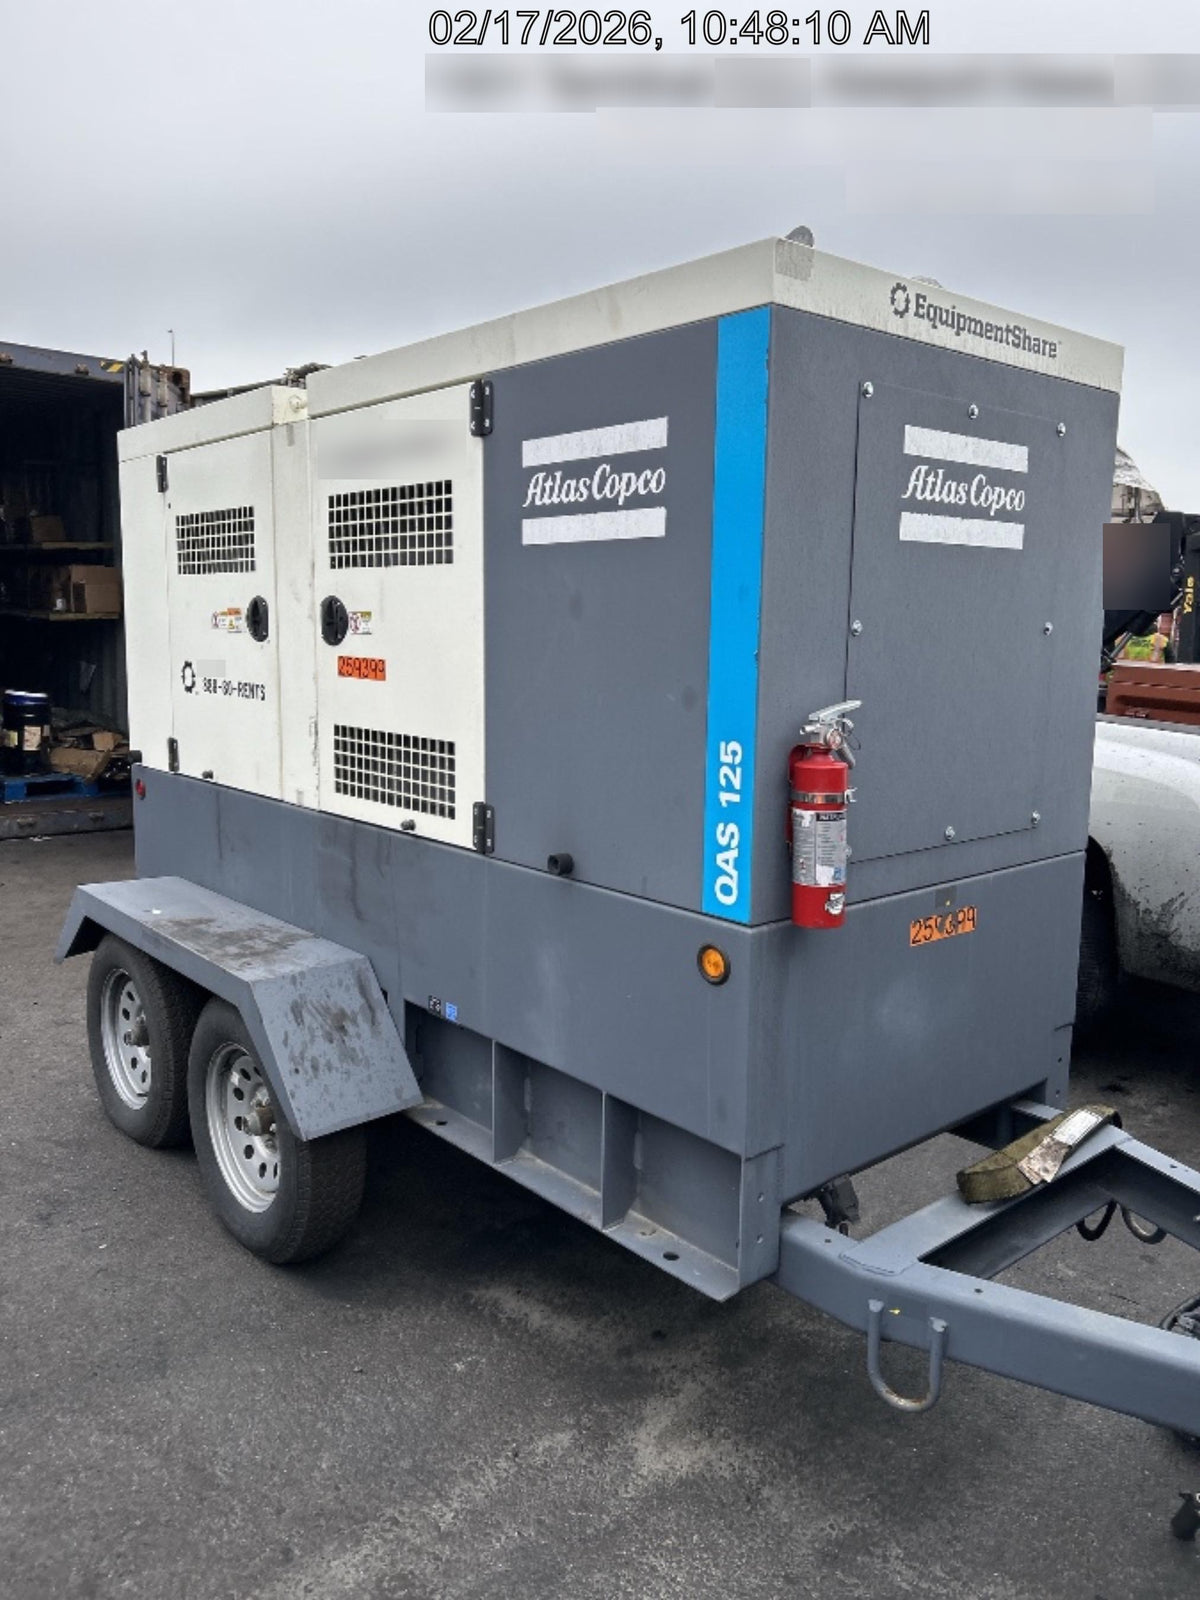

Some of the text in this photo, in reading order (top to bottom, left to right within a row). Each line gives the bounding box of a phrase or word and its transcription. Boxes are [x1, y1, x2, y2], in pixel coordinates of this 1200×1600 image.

[913, 292, 1057, 359] EquipmentShare
[714, 740, 743, 906] QAS 125
